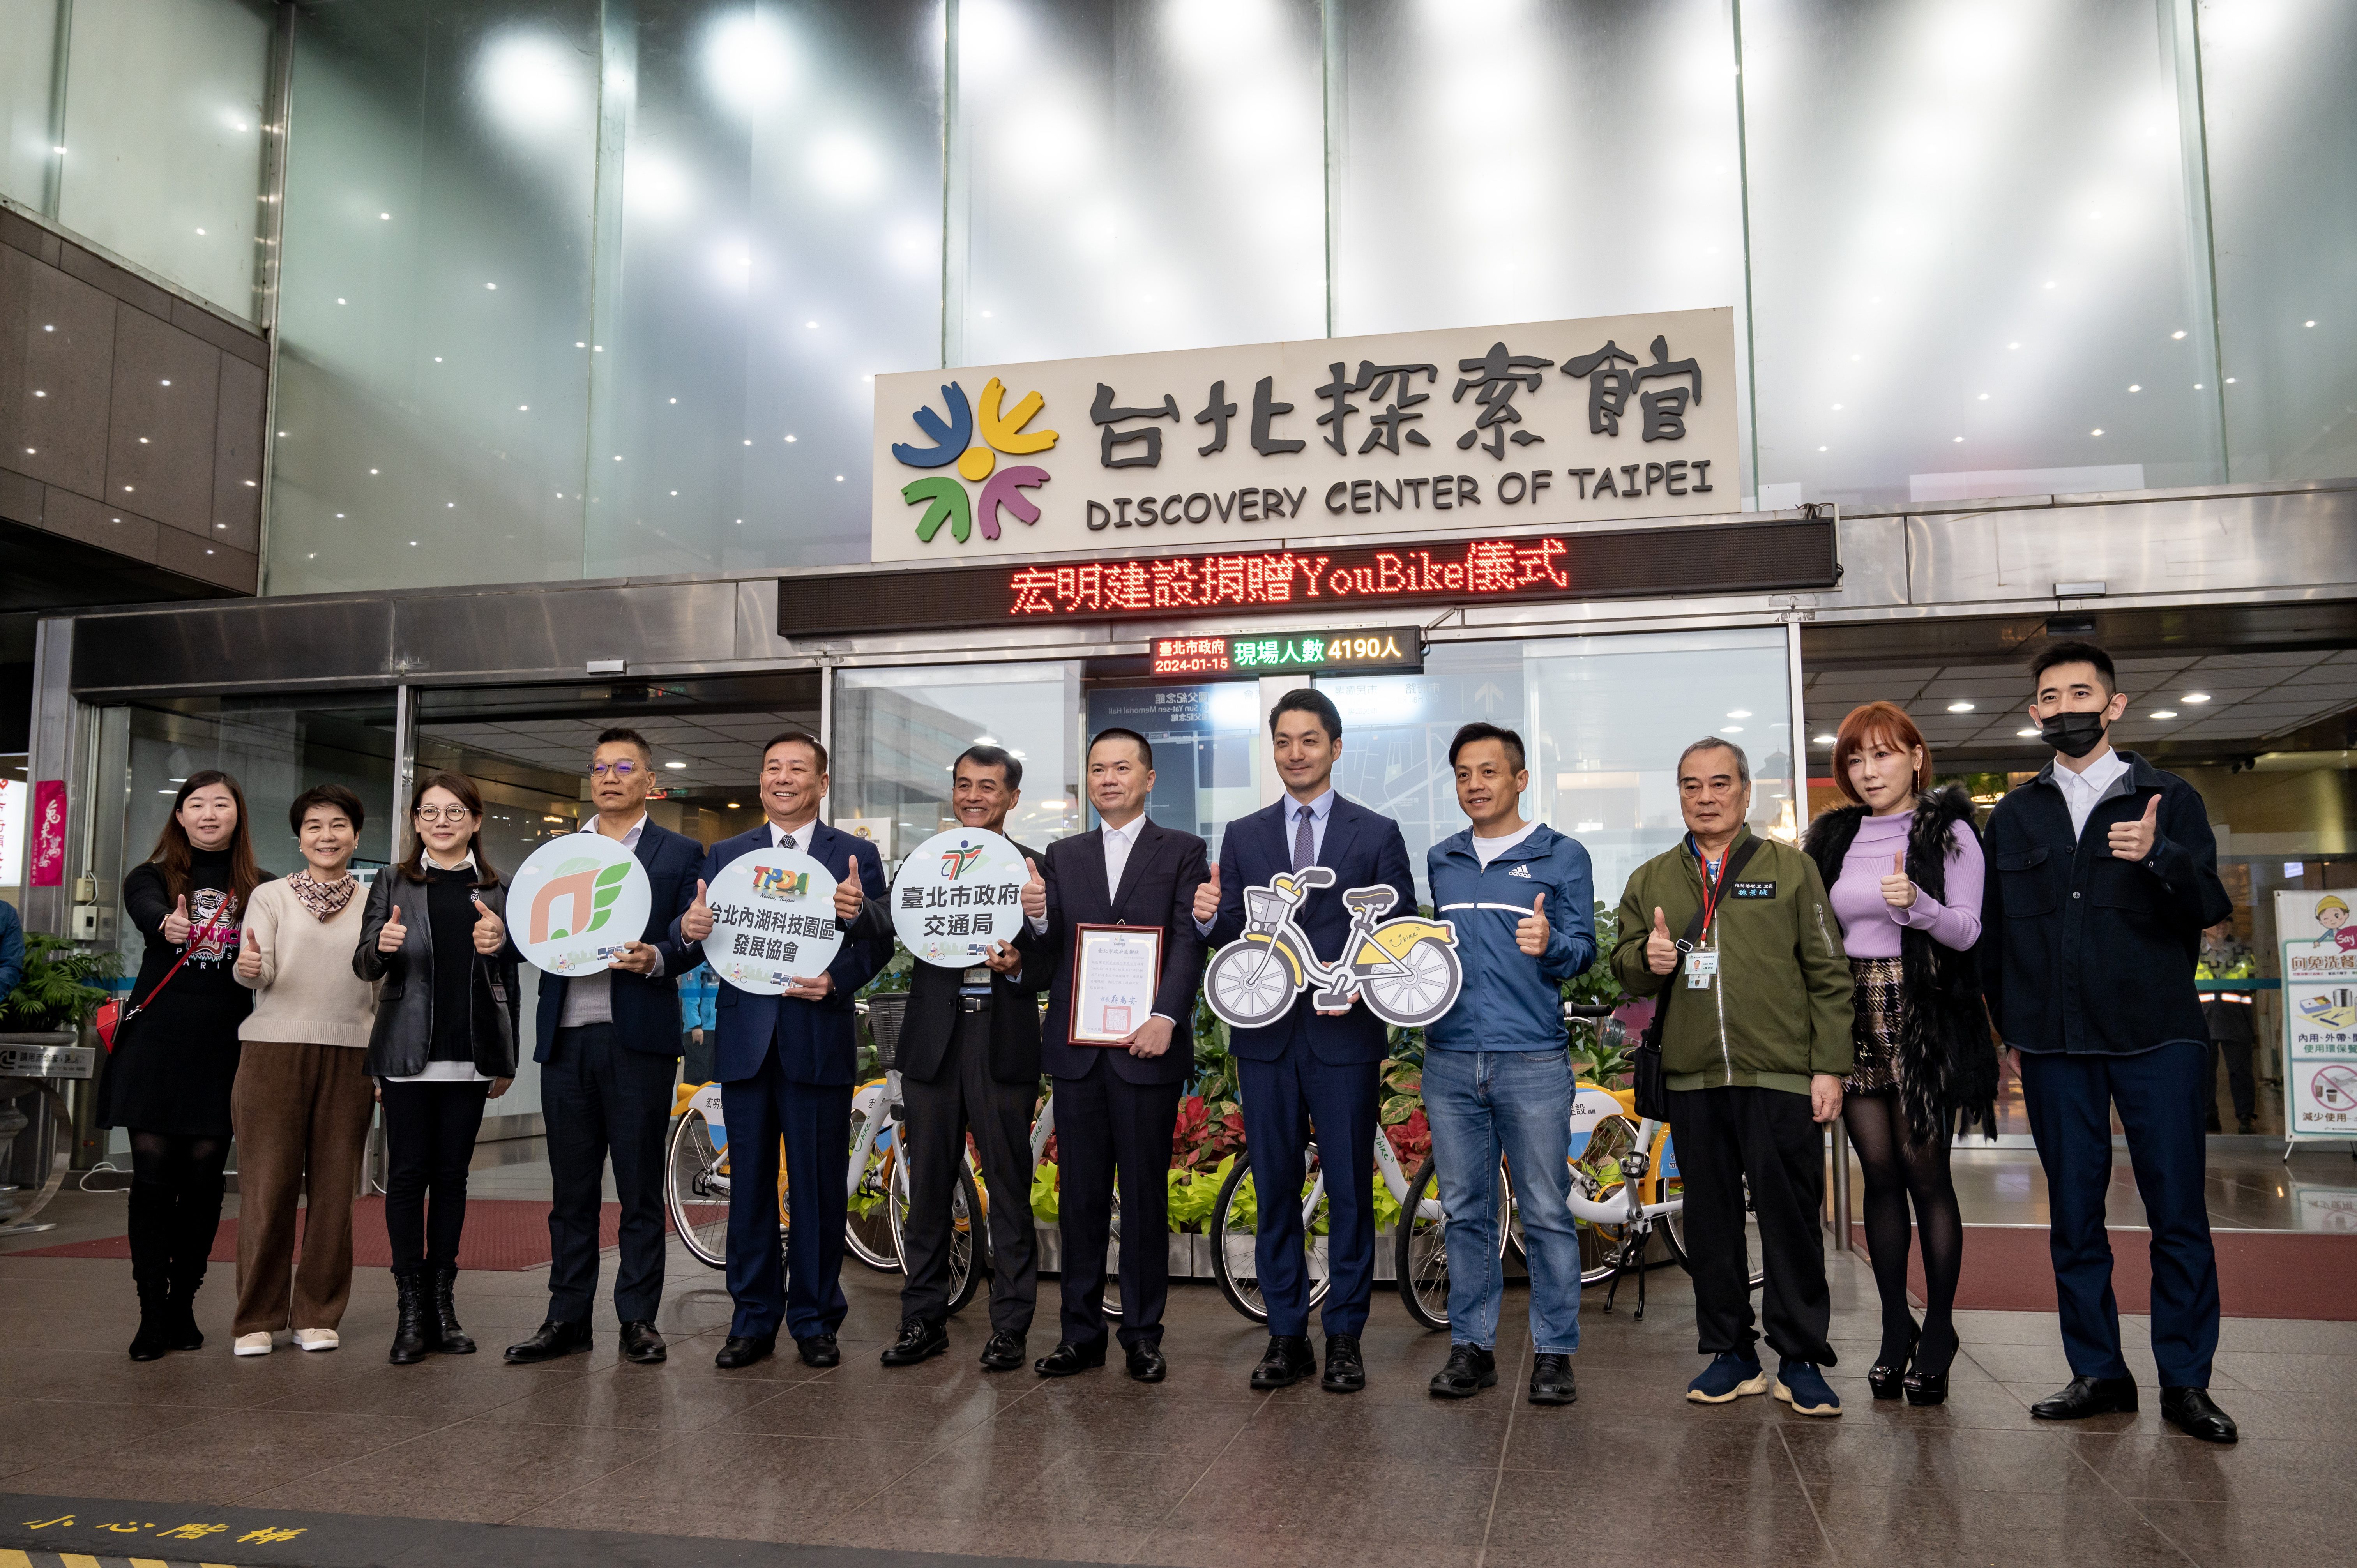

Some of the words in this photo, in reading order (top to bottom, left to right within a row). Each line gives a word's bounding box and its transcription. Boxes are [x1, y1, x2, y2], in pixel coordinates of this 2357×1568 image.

[1090, 334, 1703, 468] 台北探索館
[1087, 486, 1307, 531] DISCOVERY
[1325, 475, 1481, 515] CENTER
[1498, 470, 1553, 505] OF
[1568, 460, 1713, 499] TAIPEI
[1159, 640, 1225, 656] 臺北市政府
[1234, 638, 1325, 666] 現場人數
[1156, 659, 1228, 671] 2024-01-15
[753, 865, 810, 894] TPDA
[901, 883, 1020, 909] 臺北市政府
[923, 913, 993, 937] 交通局
[733, 933, 799, 963] 發展協會
[2337, 934, 2355, 946] Say
[22, 1514, 308, 1545] 小心階梯
